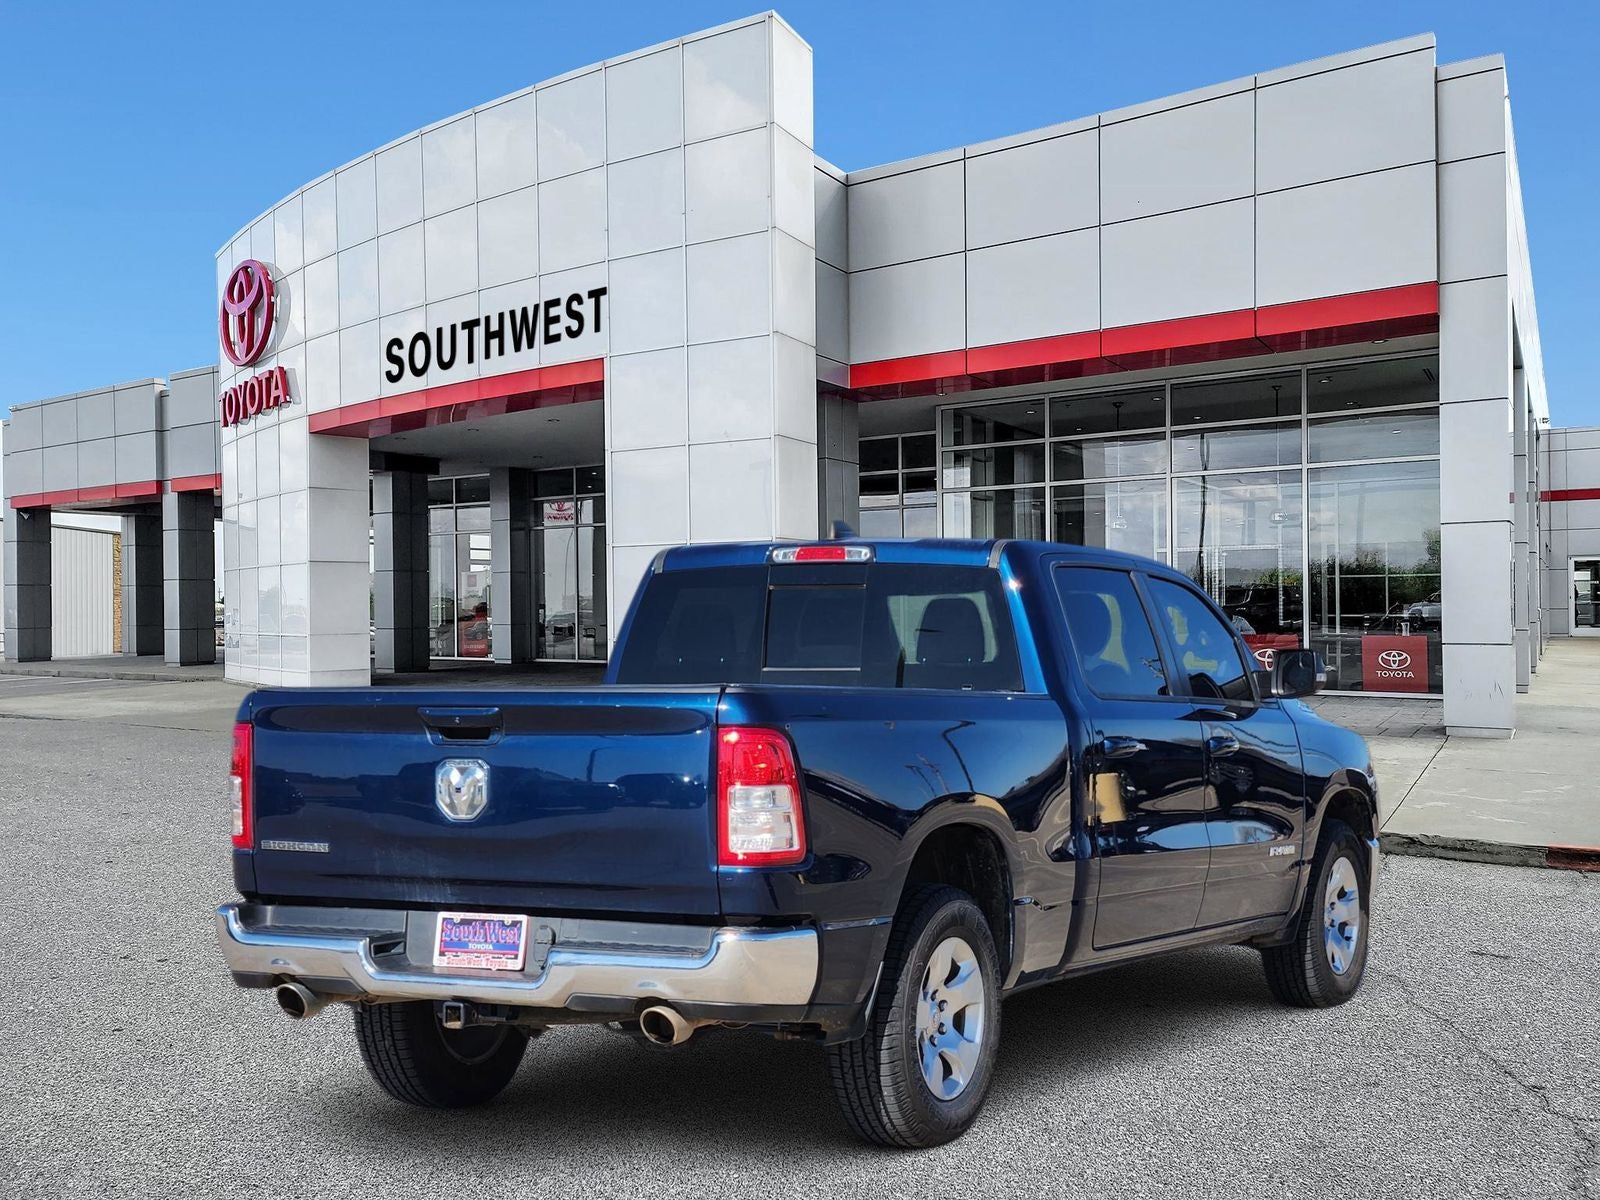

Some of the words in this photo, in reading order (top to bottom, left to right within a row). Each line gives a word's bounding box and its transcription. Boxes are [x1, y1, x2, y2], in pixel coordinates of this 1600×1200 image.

[385, 286, 608, 384] SOUTHWEST
[218, 366, 290, 427] TOYOTA
[1375, 670, 1415, 678] TOYOTA
